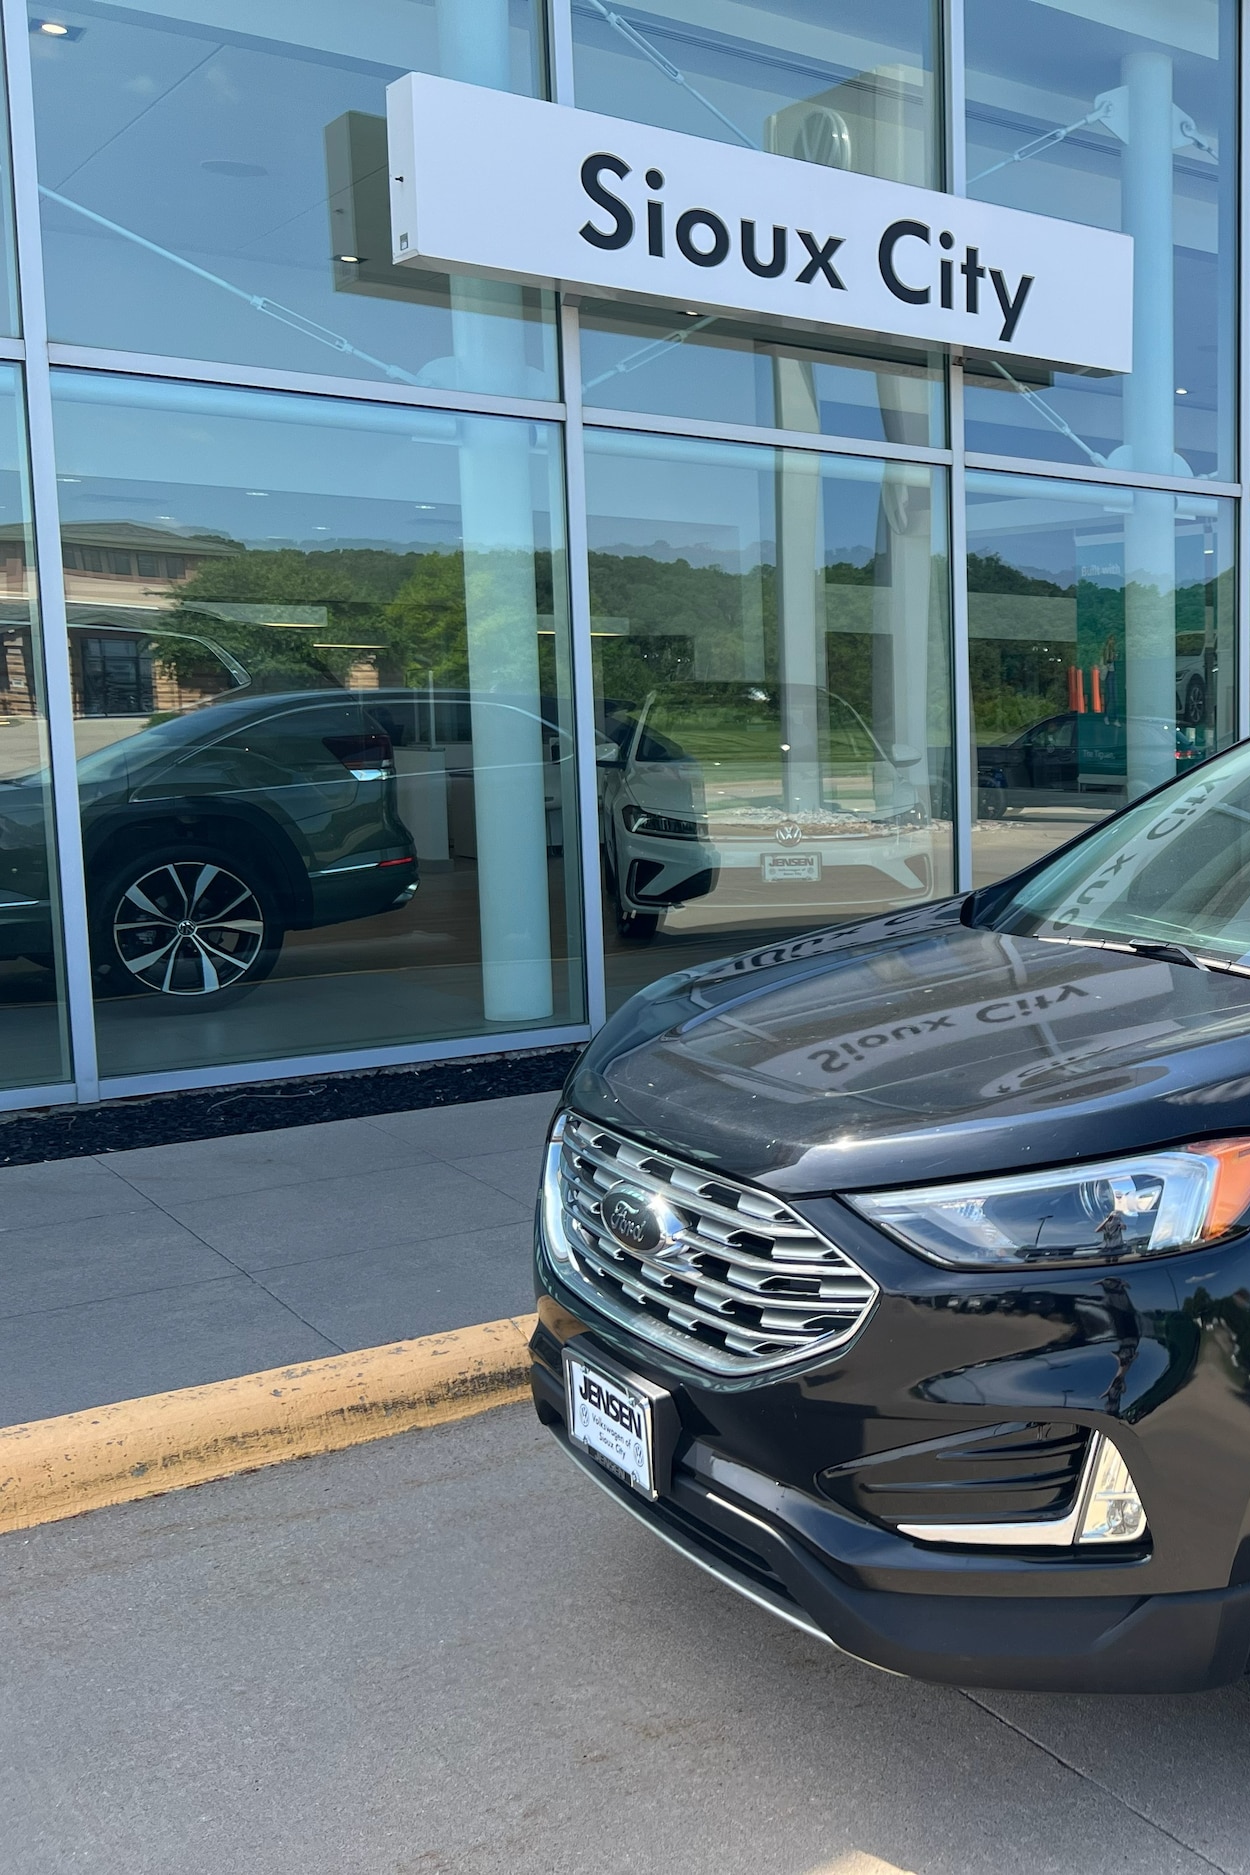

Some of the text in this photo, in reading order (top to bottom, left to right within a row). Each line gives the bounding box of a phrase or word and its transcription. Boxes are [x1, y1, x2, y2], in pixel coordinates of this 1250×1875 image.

[579, 152, 1034, 342] Sioux City
[1081, 562, 1121, 576] Built with
[769, 858, 814, 867] JENSEN
[610, 1200, 647, 1243] Ford
[579, 1375, 642, 1440] JENSEN
[592, 1413, 631, 1450] Volkswagen of
[599, 1431, 626, 1460] Sioux City
